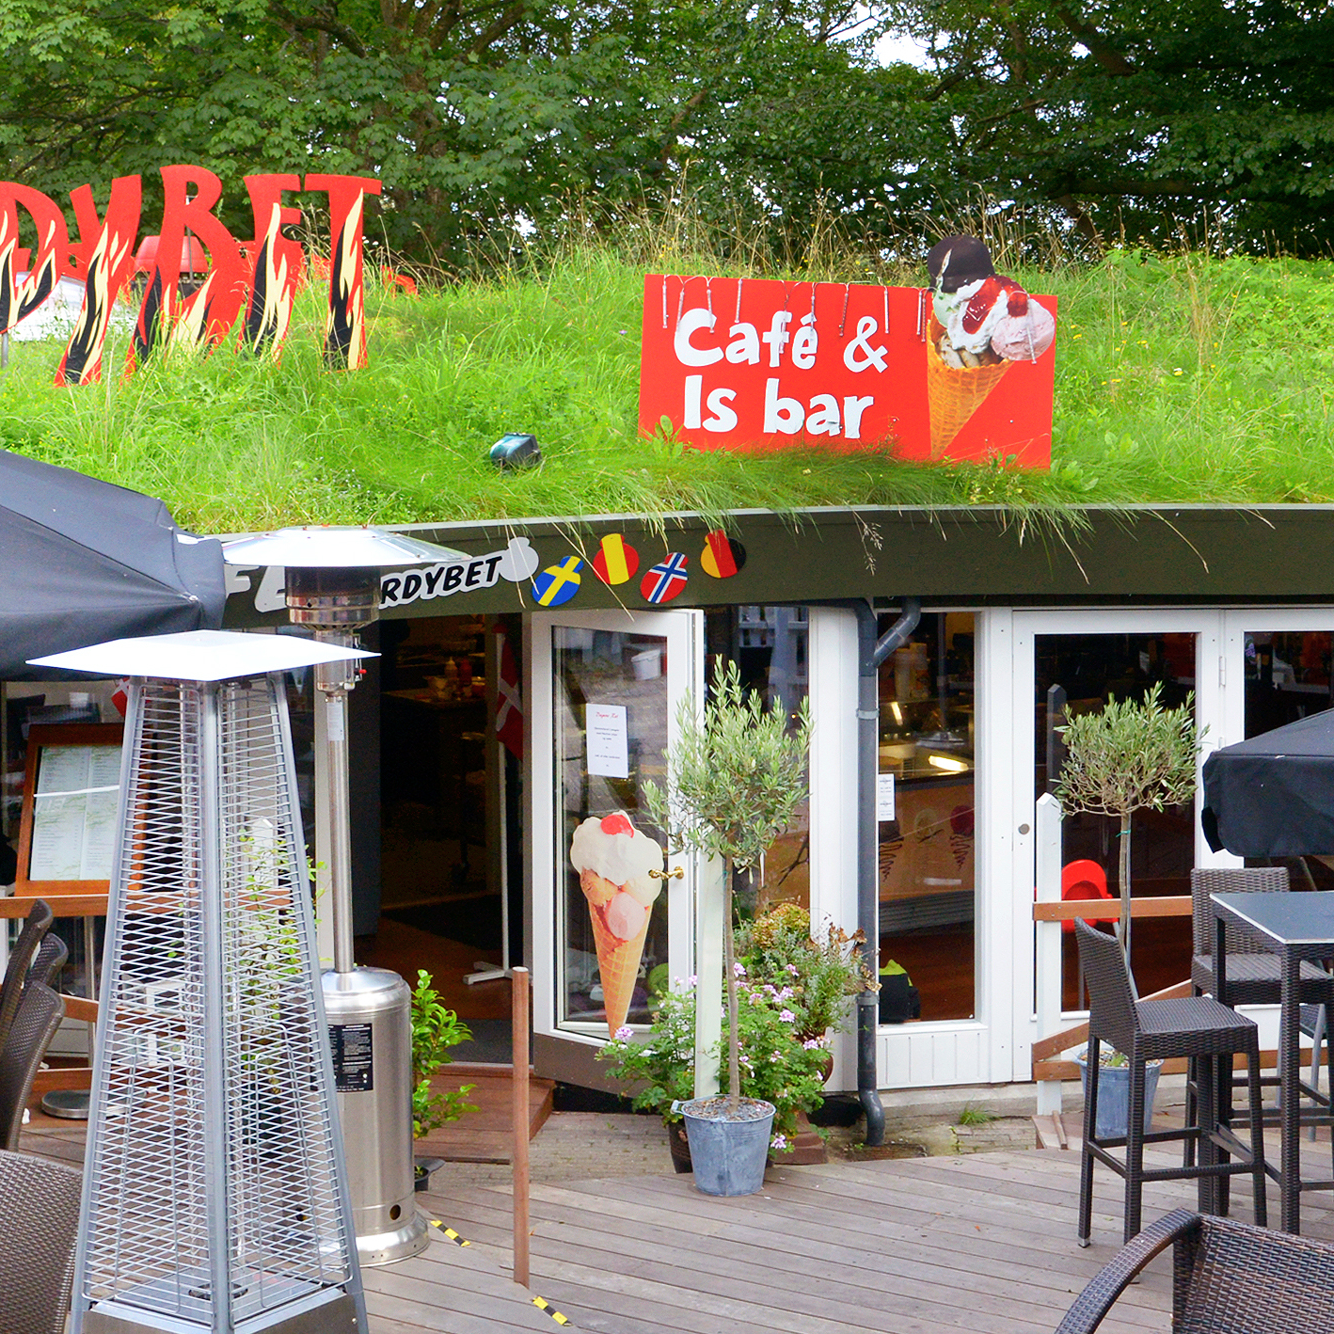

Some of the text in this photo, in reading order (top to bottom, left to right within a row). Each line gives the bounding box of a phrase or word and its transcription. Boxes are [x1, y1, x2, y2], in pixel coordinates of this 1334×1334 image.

[674, 308, 889, 373] Café &
[682, 375, 874, 439] Is bar
